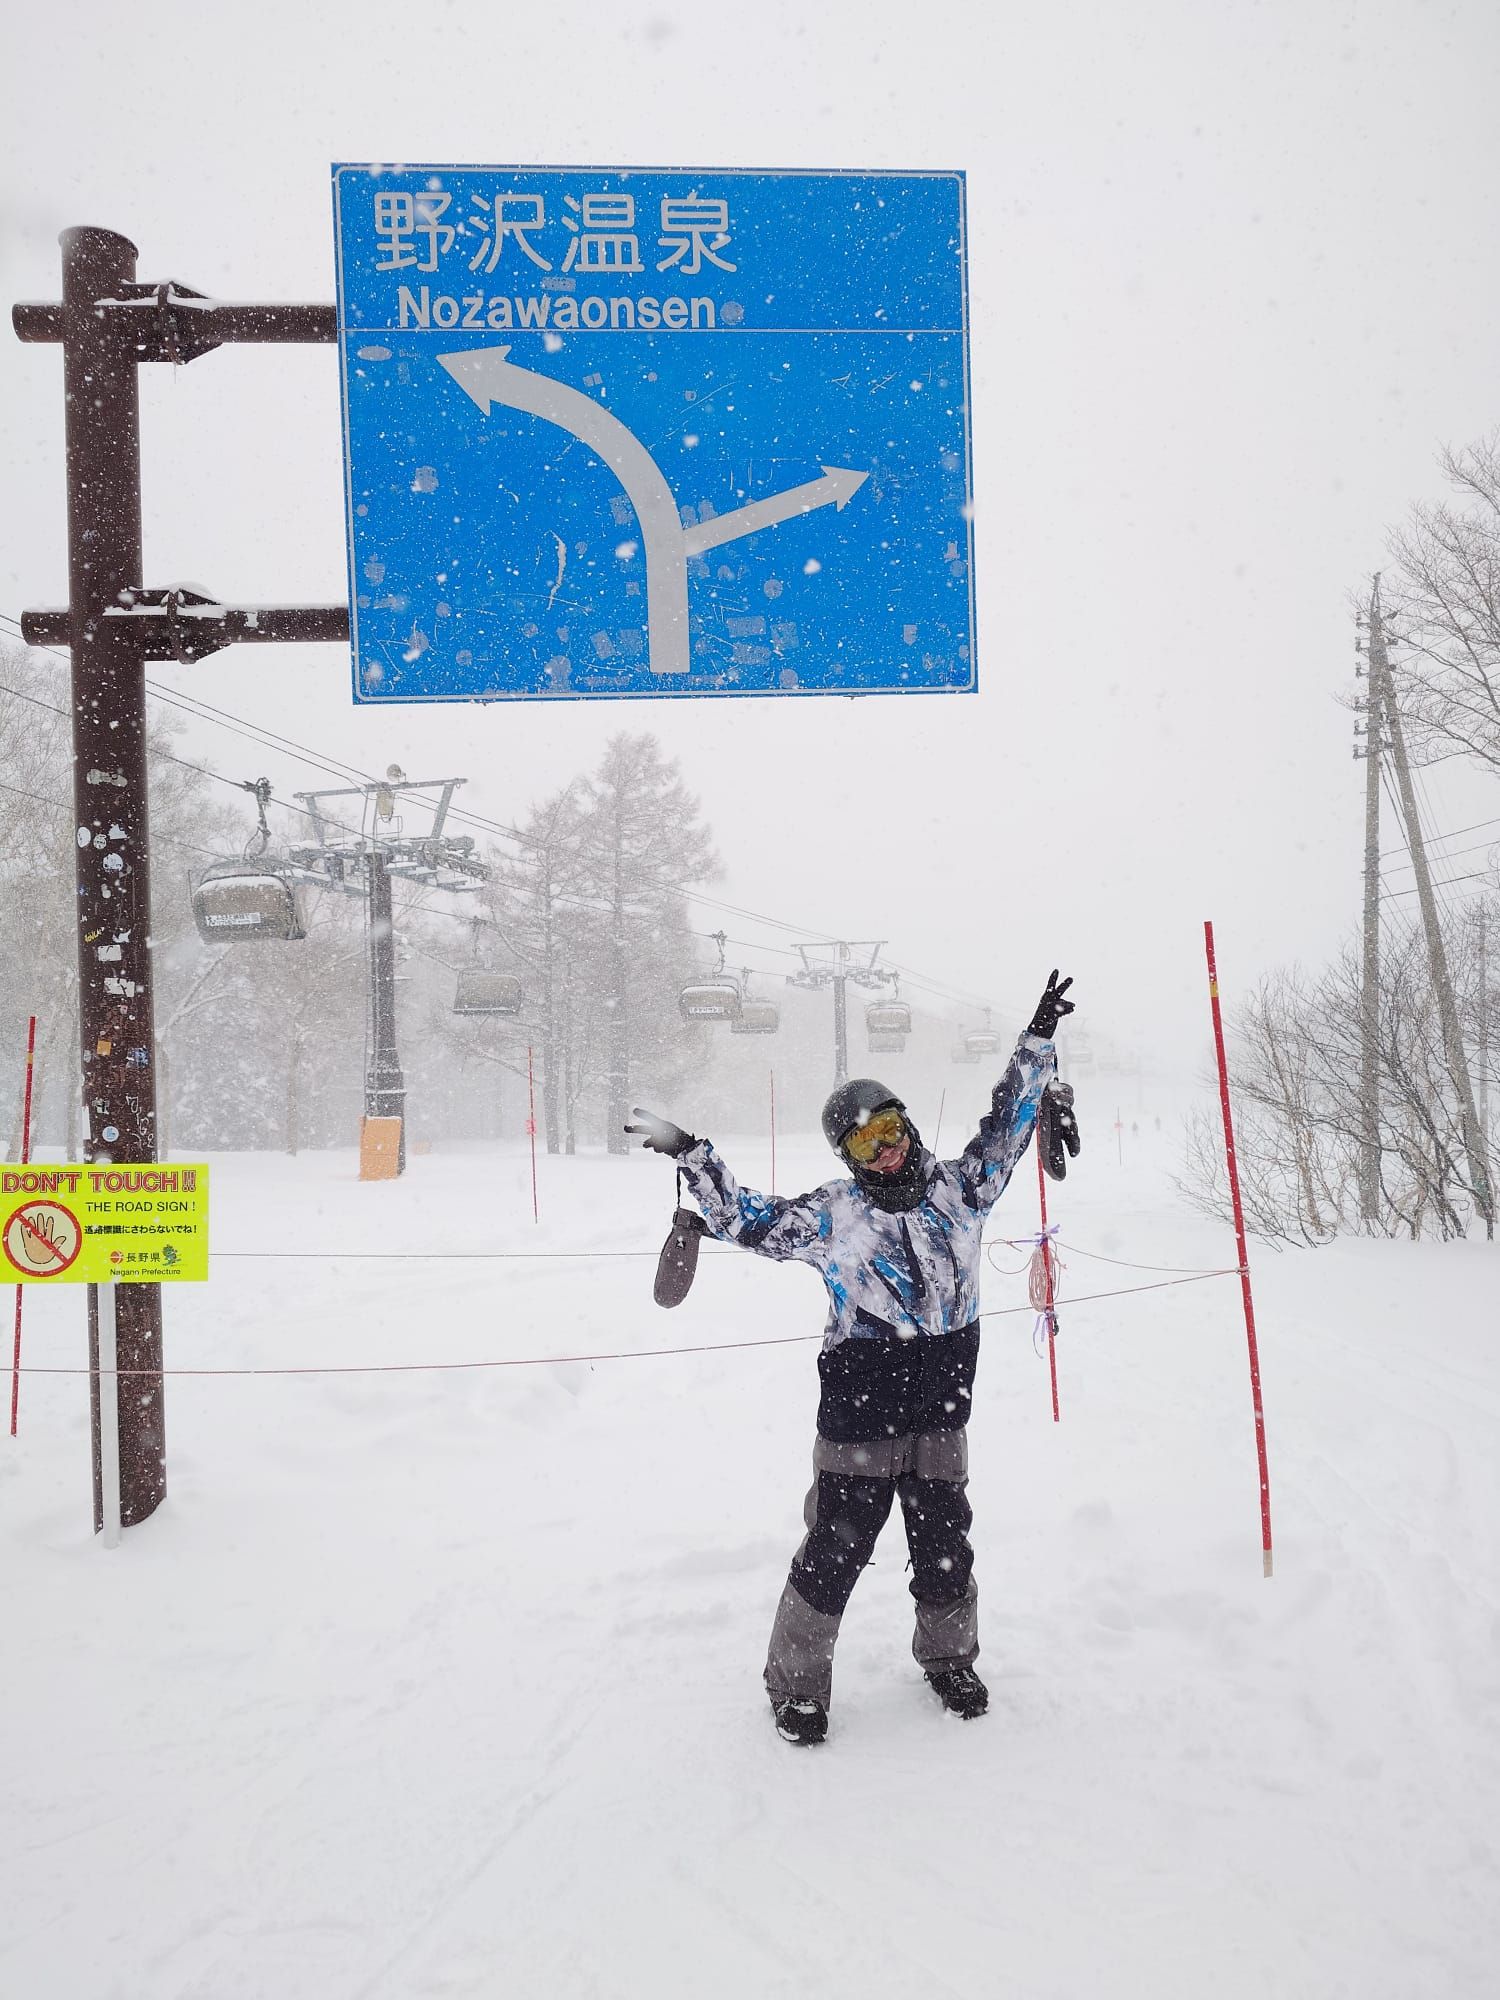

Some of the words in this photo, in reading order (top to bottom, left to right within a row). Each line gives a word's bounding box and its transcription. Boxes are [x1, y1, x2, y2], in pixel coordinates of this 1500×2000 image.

[374, 191, 737, 273] 野沢温泉
[399, 286, 716, 329] Nozawaonsen
[2, 1172, 82, 1193] DON'T
[85, 1202, 111, 1212] THE
[116, 1202, 153, 1212] ROAD
[126, 1252, 160, 1263] 長野県
[110, 1268, 139, 1277] Nagano
[142, 1268, 181, 1276] Prefecture
